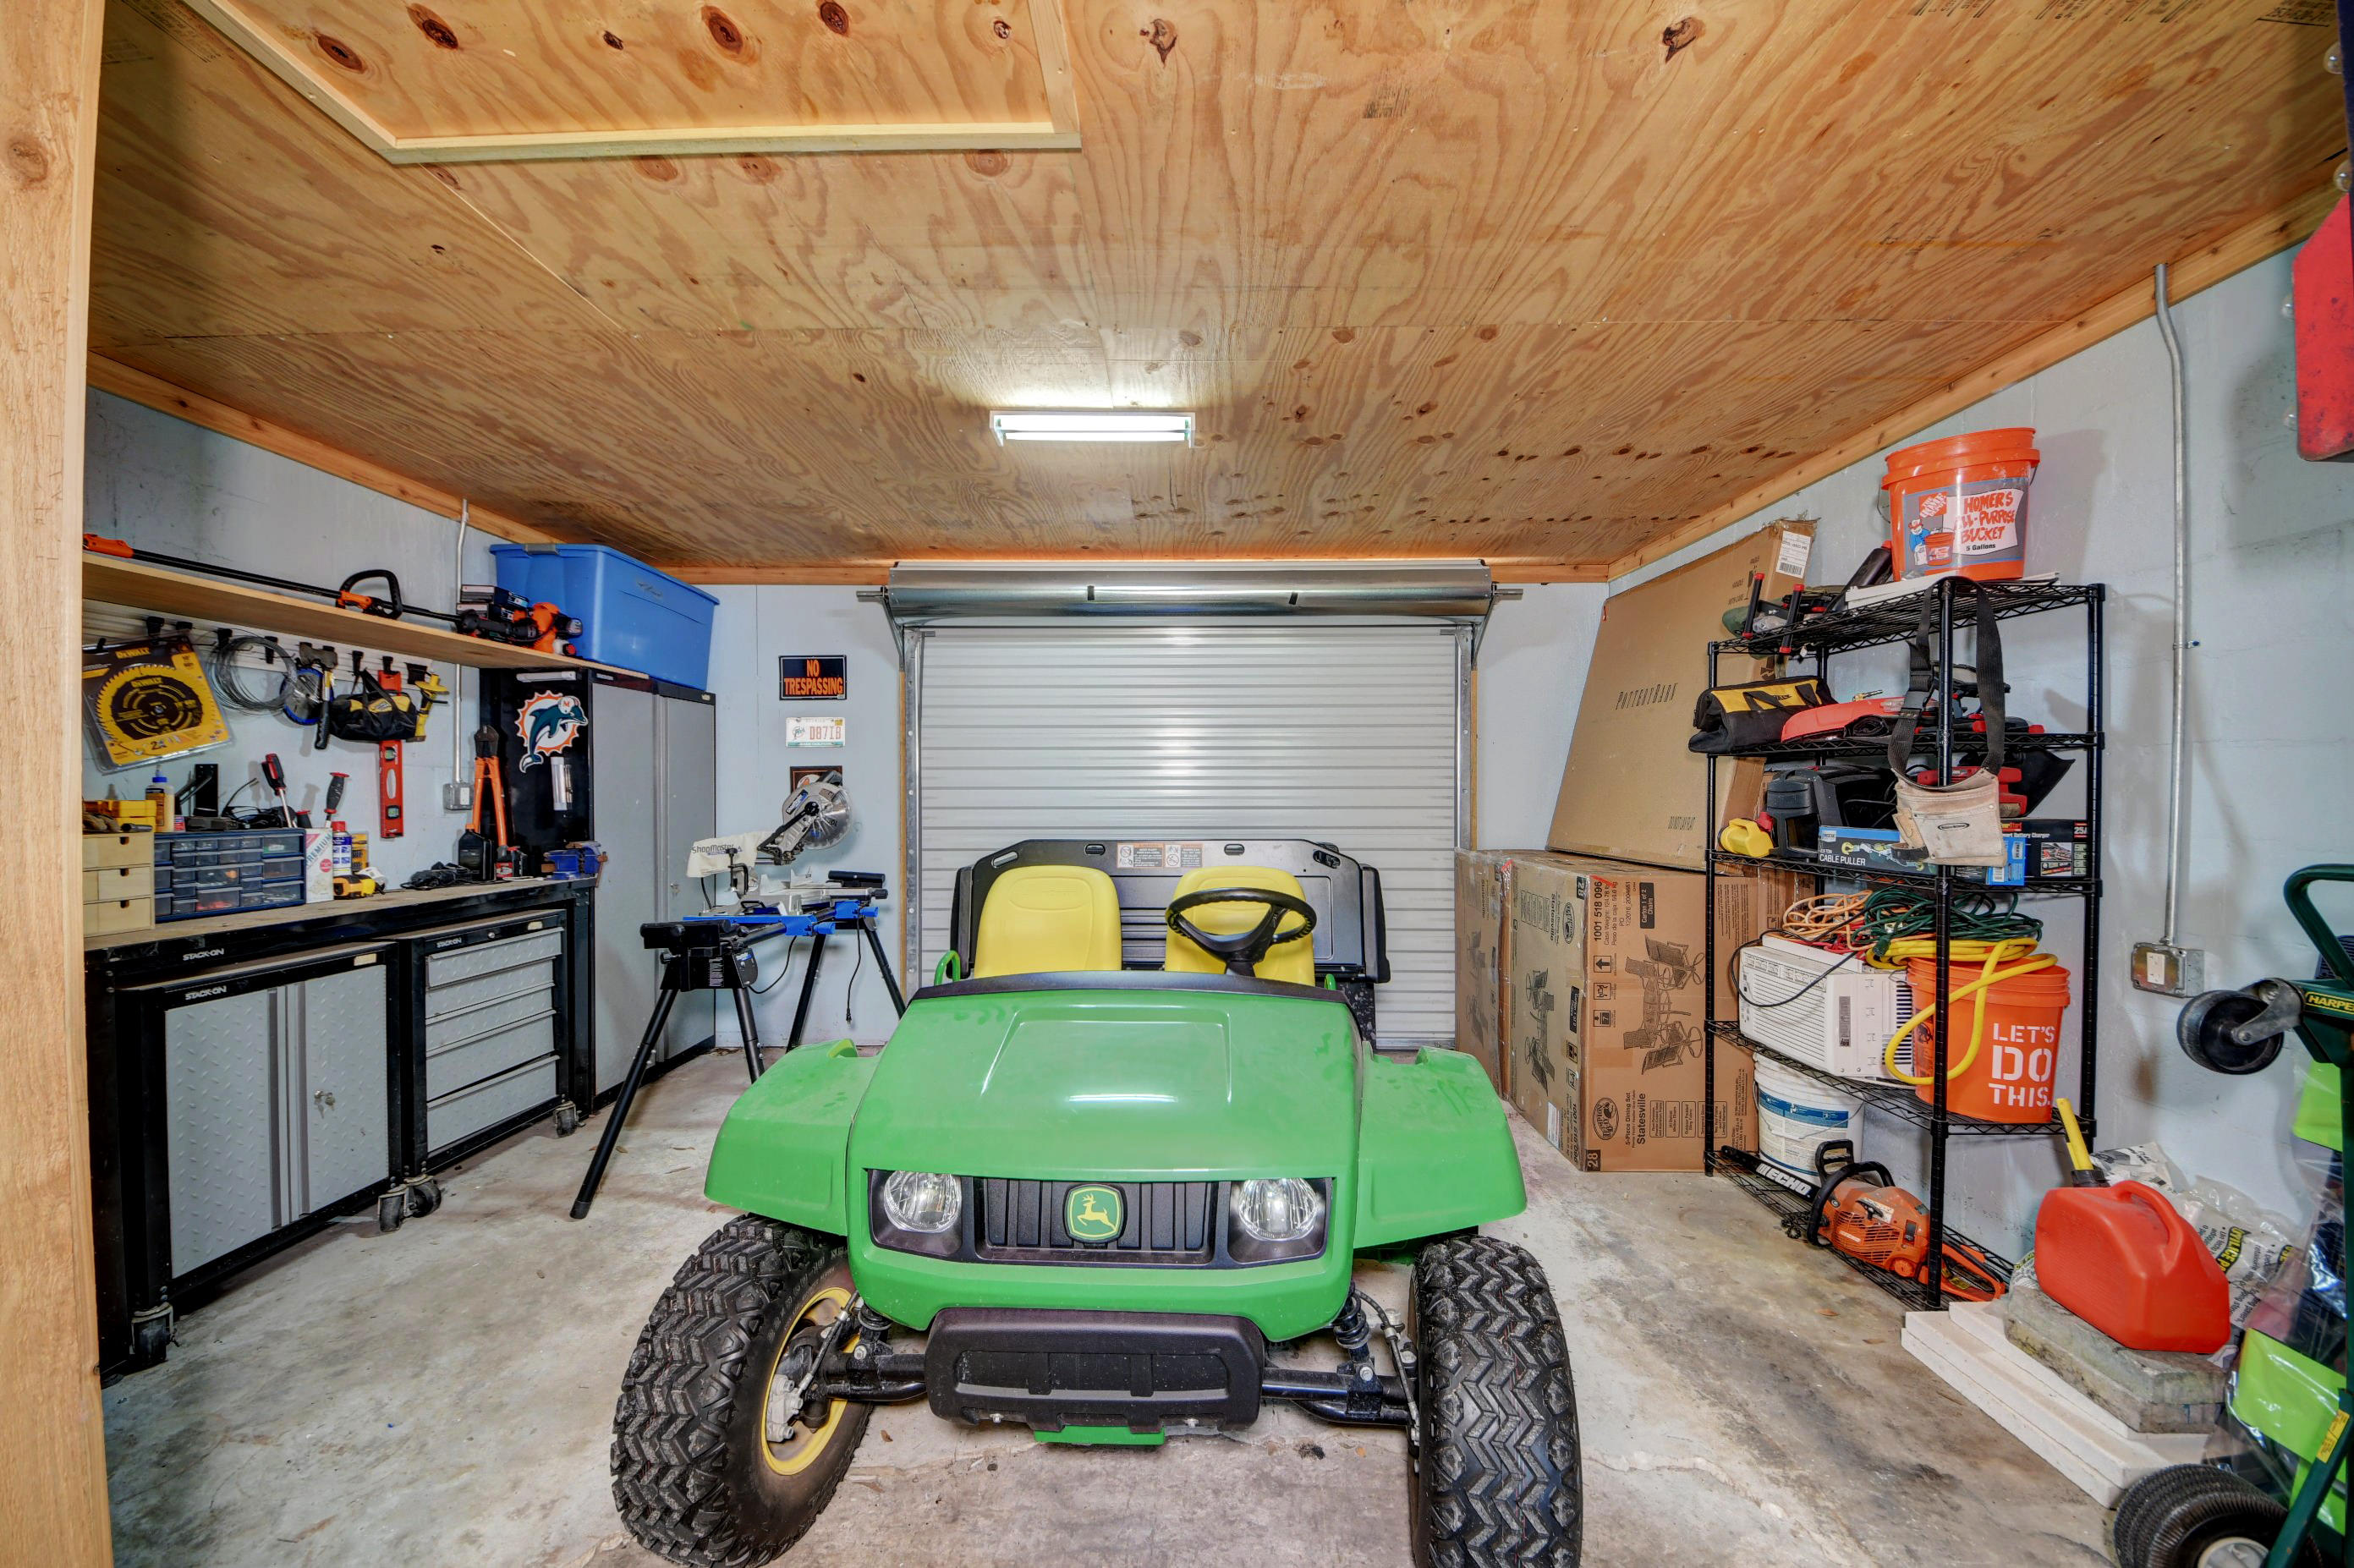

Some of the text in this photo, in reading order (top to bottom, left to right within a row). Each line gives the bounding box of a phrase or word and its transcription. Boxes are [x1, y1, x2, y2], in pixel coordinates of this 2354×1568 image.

[1963, 491, 2013, 514] HOMER'S
[1961, 525, 2005, 544] BUCKET
[806, 659, 820, 677] NO
[784, 677, 843, 695] TRESPASSING
[692, 844, 734, 853] ShopMaster
[1819, 853, 1866, 866] CABLE PULLER
[1619, 918, 1624, 926] PO
[183, 948, 225, 961] STACK-ON
[185, 985, 227, 1001] STACK-ON
[2308, 995, 2354, 1012] HARPE
[1993, 1022, 2055, 1044] LET'S
[1992, 1044, 2053, 1083] DO
[1988, 1083, 2051, 1108] THIS.
[1637, 1094, 1646, 1144] Statesville
[1587, 1153, 1598, 1167] 28
